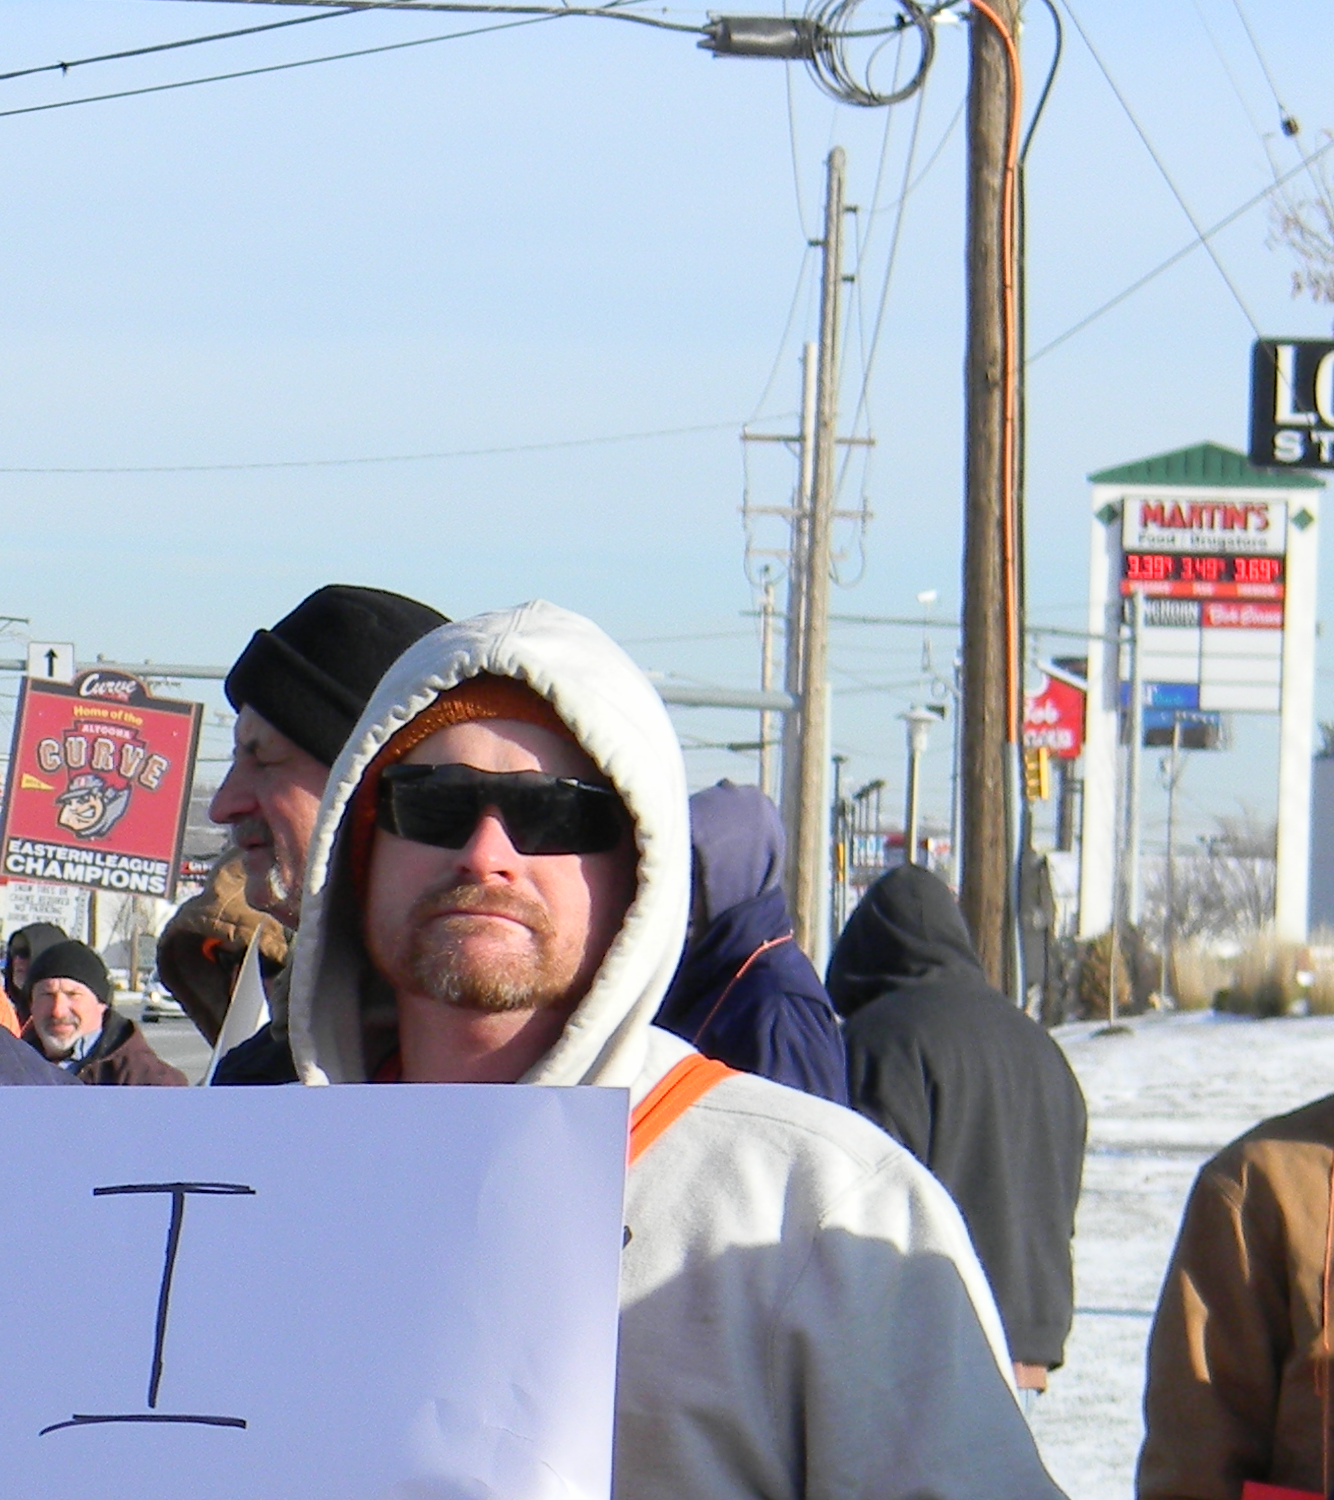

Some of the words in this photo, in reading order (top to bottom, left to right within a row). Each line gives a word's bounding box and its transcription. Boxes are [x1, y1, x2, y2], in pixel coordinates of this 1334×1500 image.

[1140, 501, 1270, 531] MARTIN'S
[74, 705, 109, 719] Home
[110, 707, 123, 720] of
[122, 711, 144, 726] the
[82, 723, 133, 740] ALTOONA
[37, 736, 170, 791] CURVE
[6, 855, 166, 893] CHAMPIONS
[9, 839, 94, 865] EASTERN
[95, 854, 168, 876] LEAGUE
[39, 1181, 257, 1436] I
